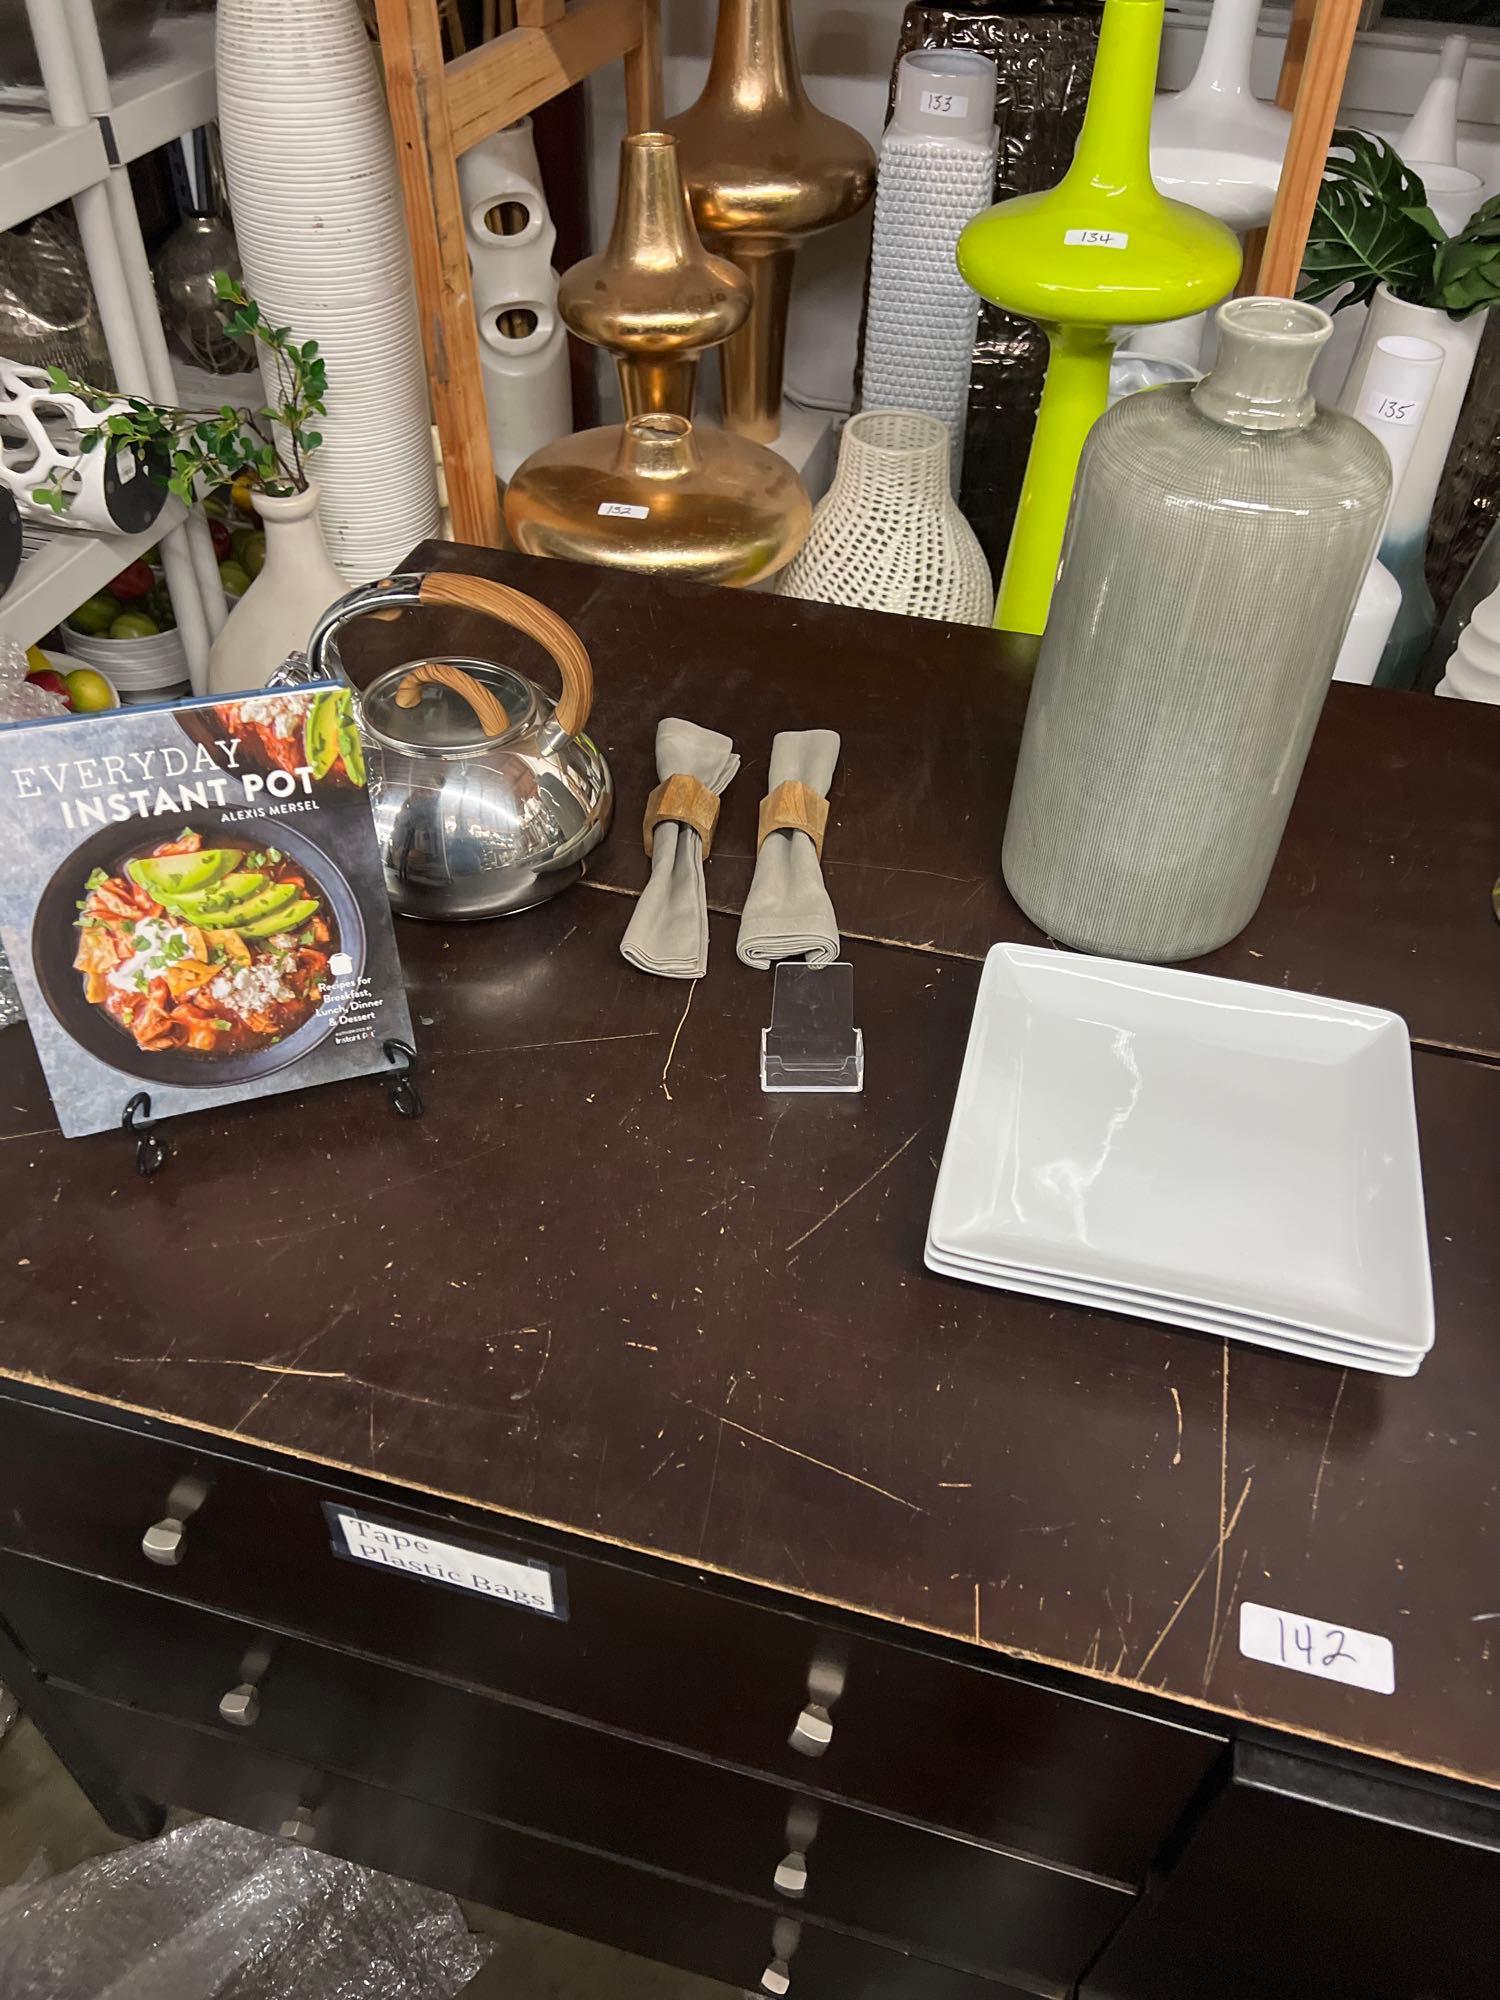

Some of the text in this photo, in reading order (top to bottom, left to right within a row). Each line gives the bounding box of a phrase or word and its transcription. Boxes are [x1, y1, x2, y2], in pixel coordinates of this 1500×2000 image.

[928, 94, 953, 112] 133
[1081, 231, 1115, 244] 134
[1378, 398, 1416, 419] 135
[12, 738, 241, 798] EVERYDAY
[62, 766, 314, 829] INSTANT POT
[221, 800, 320, 822] ALEXIS MERSEL
[318, 976, 372, 992] Recipes for
[323, 989, 372, 1003] Breakfast,
[315, 999, 384, 1017] Lunch, Dinner
[328, 1012, 376, 1027] & Dessert
[350, 1519, 428, 1552] Tape
[360, 1544, 545, 1605] Plastic Bags
[1279, 1617, 1358, 1666] 142
